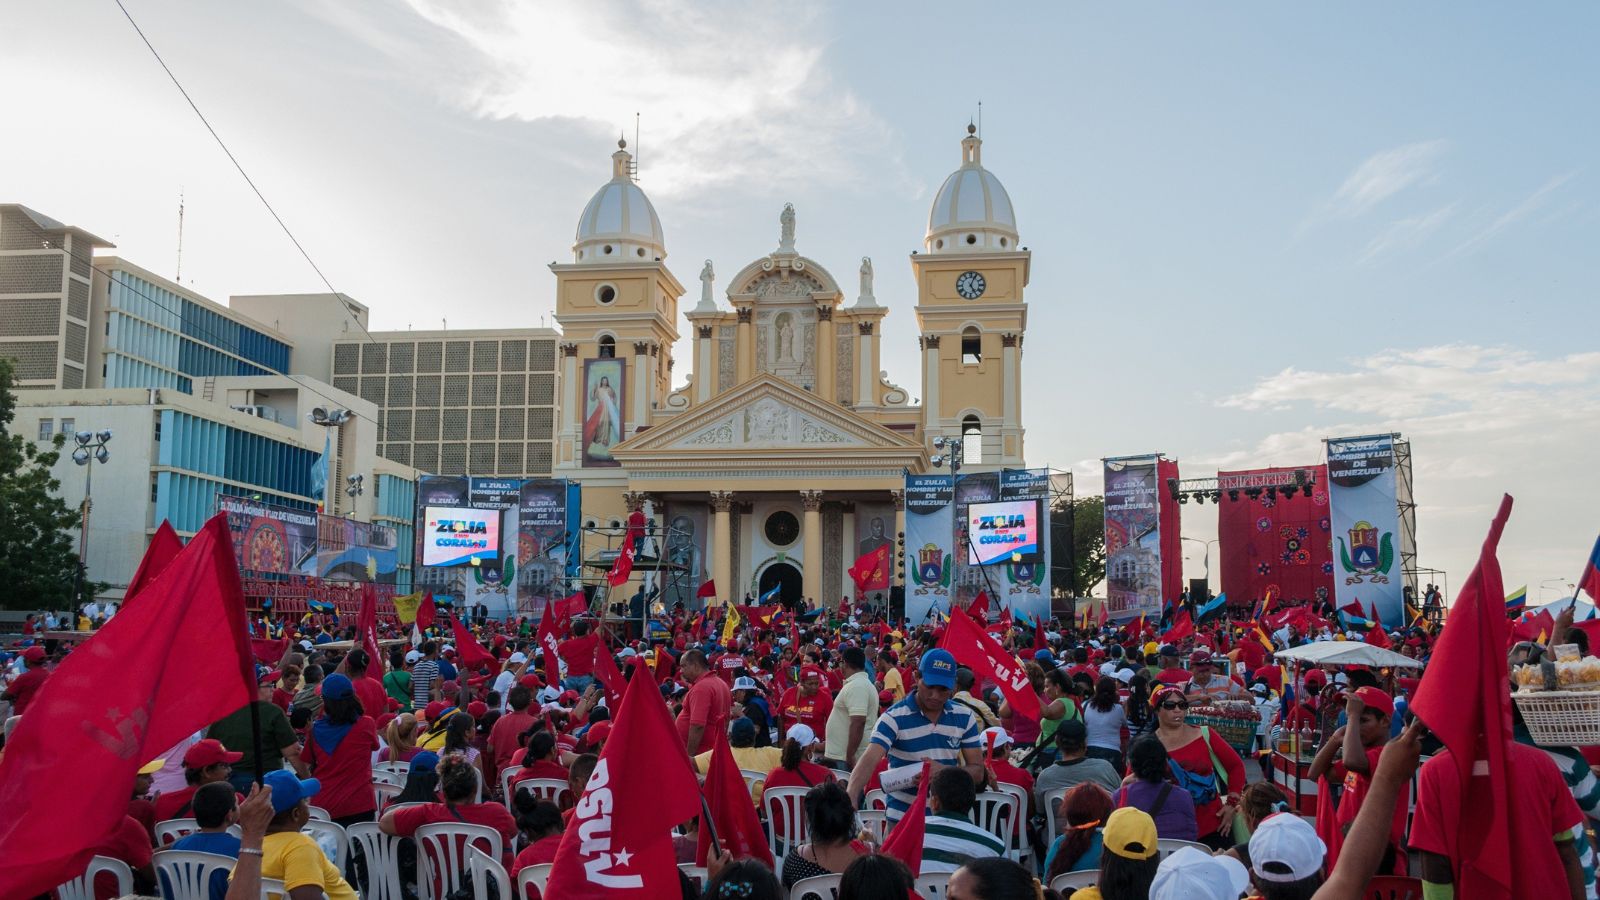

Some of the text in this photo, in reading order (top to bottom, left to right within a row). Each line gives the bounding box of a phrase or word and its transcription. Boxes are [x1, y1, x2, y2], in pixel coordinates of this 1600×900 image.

[1328, 453, 1366, 461] NOMBRE
[1331, 467, 1389, 478] VENEZUELA
[1123, 480, 1146, 488] ZULIA
[1105, 489, 1135, 497] NOMBRE
[1108, 502, 1153, 510] VENEZUELA
[286, 512, 316, 526] VENEZUELA
[979, 514, 1026, 530] ZULIA
[436, 519, 487, 534] ZULIA
